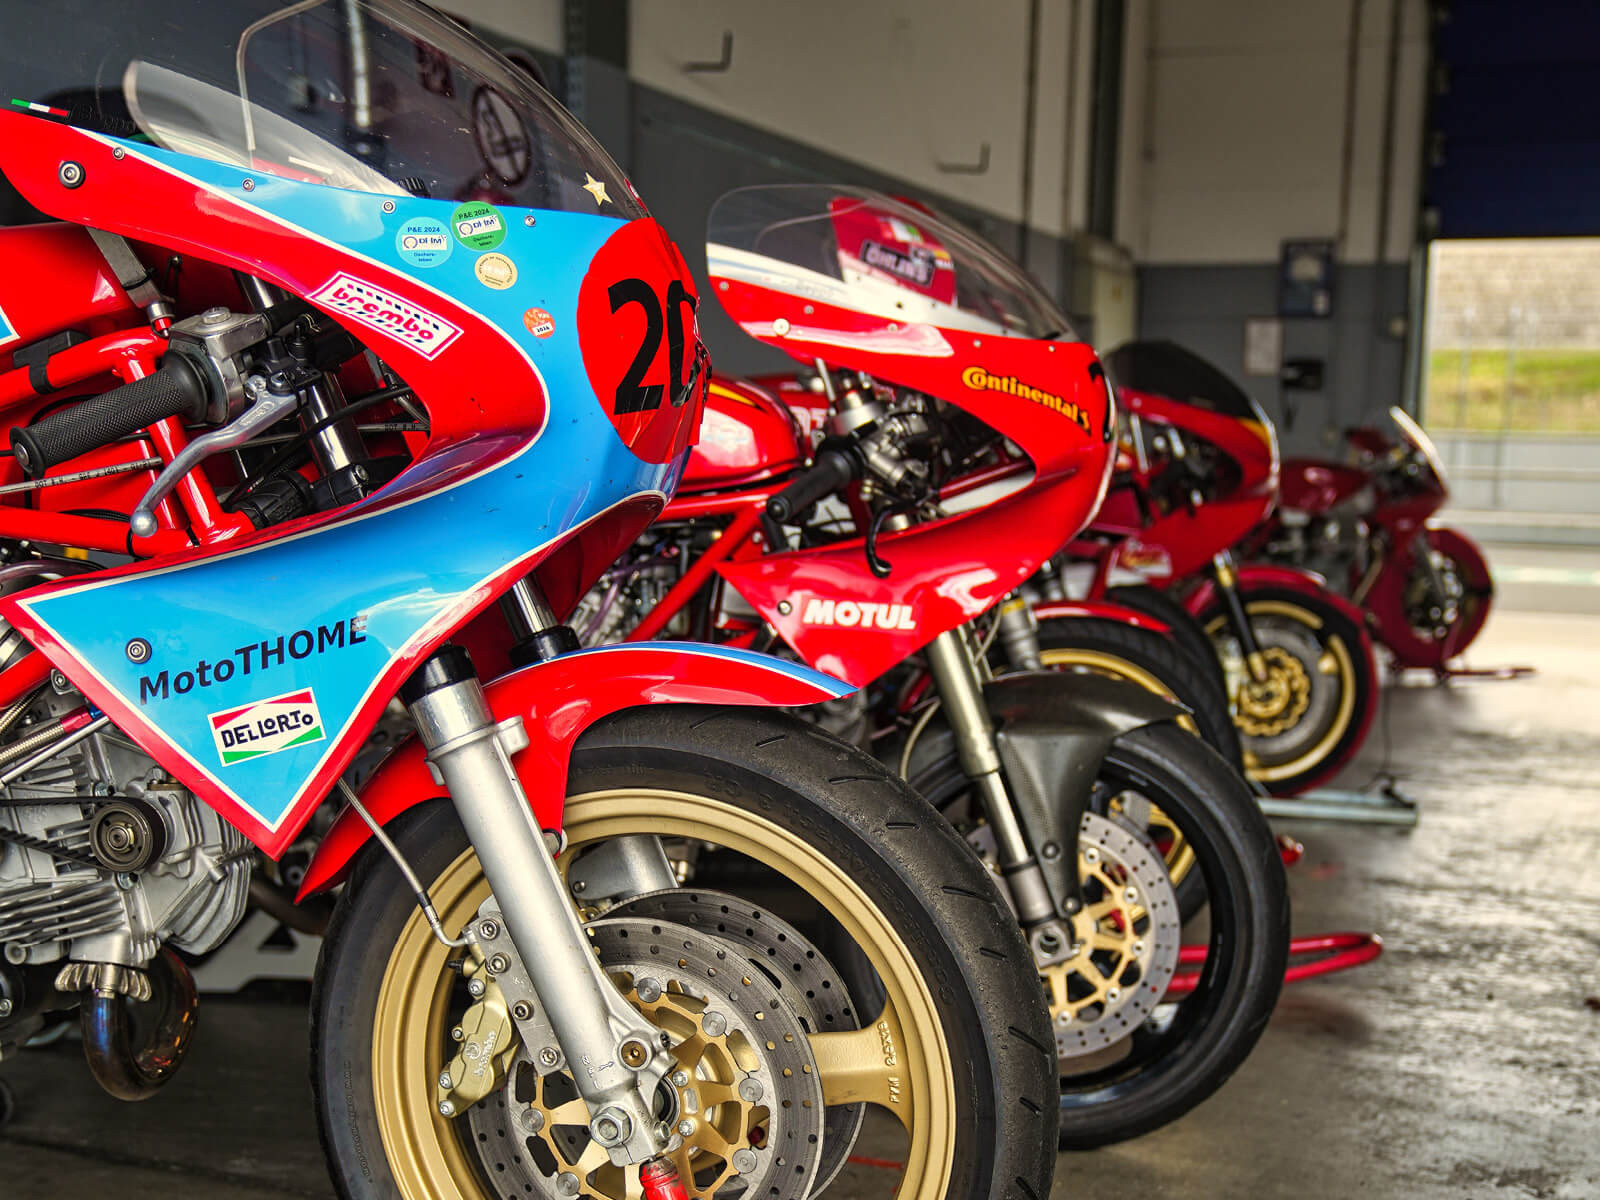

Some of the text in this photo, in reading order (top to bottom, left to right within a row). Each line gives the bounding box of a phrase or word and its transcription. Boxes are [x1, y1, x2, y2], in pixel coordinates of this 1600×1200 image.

[474, 207, 490, 217] 2024
[332, 287, 434, 340] brembo
[961, 366, 1079, 423] Continental
[803, 599, 916, 630] MOTUL
[139, 614, 369, 706] MotoTHOME
